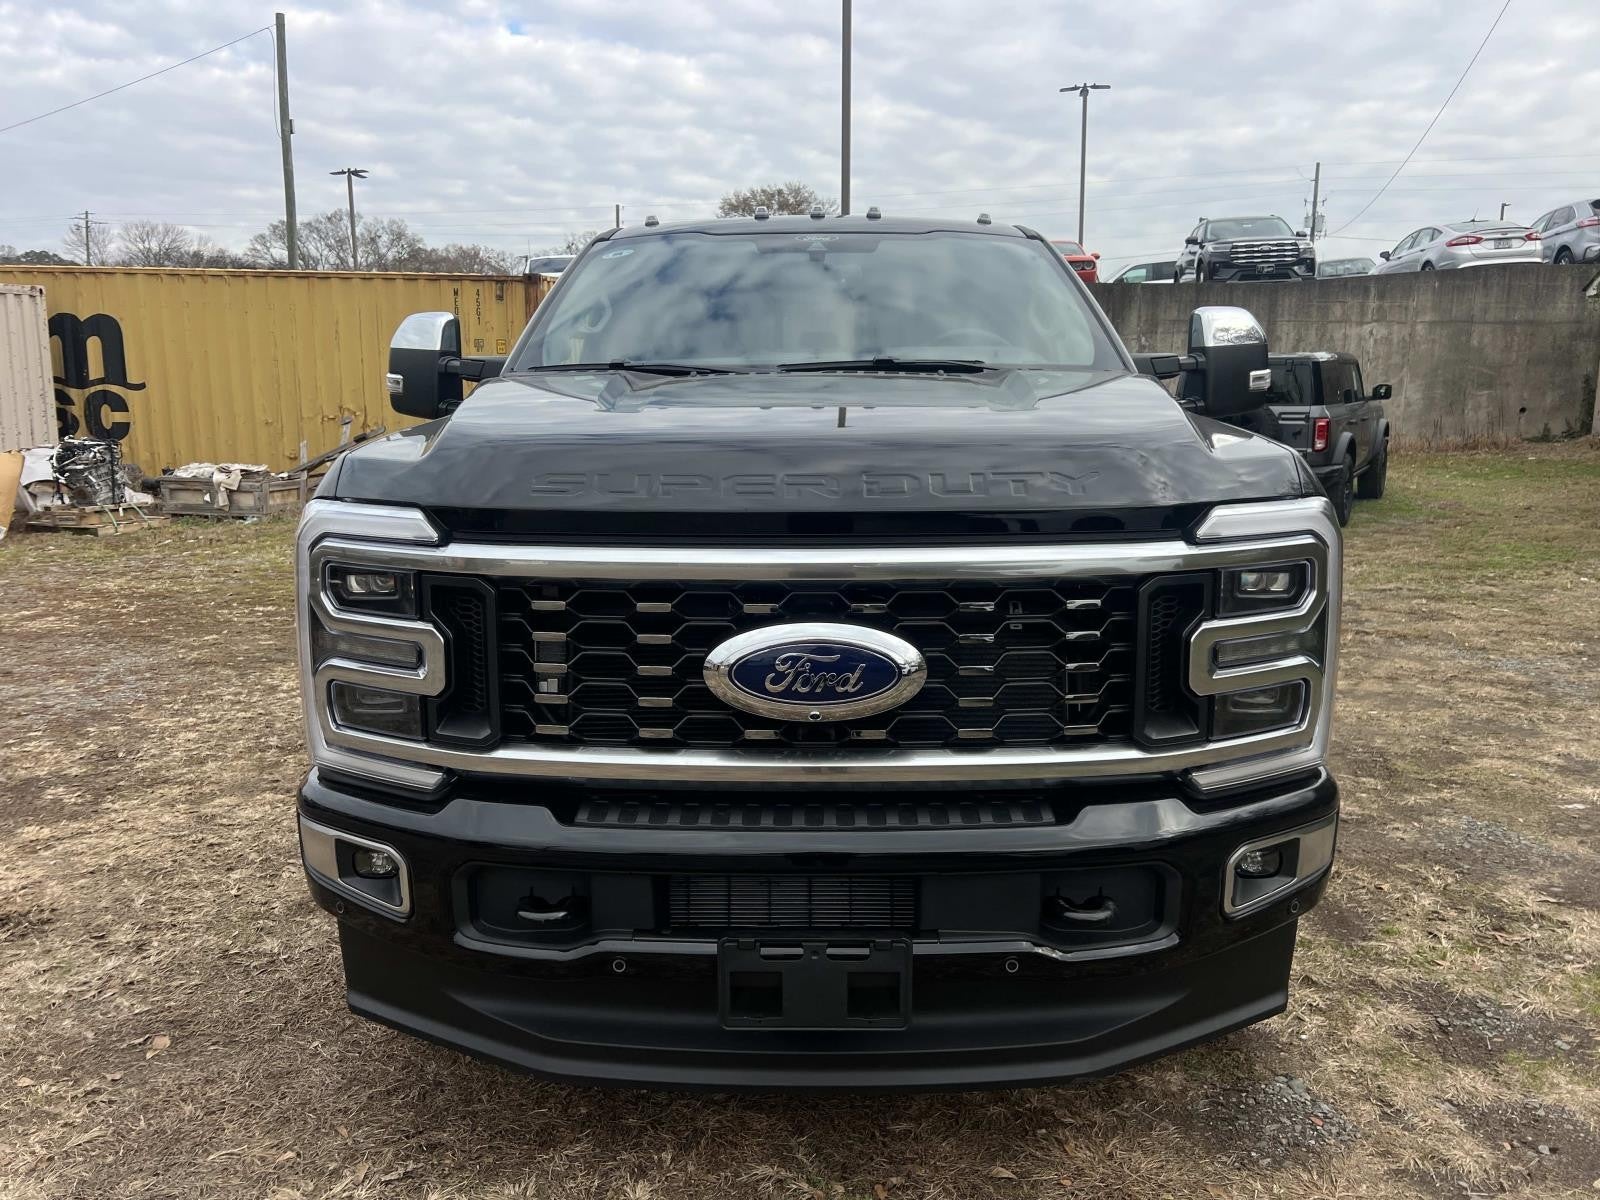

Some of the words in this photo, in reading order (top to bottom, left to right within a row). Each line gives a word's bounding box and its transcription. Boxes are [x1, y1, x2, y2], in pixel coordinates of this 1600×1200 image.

[530, 471, 841, 498] SUPER
[862, 470, 1100, 498] DUTY
[764, 652, 866, 693] Ford
